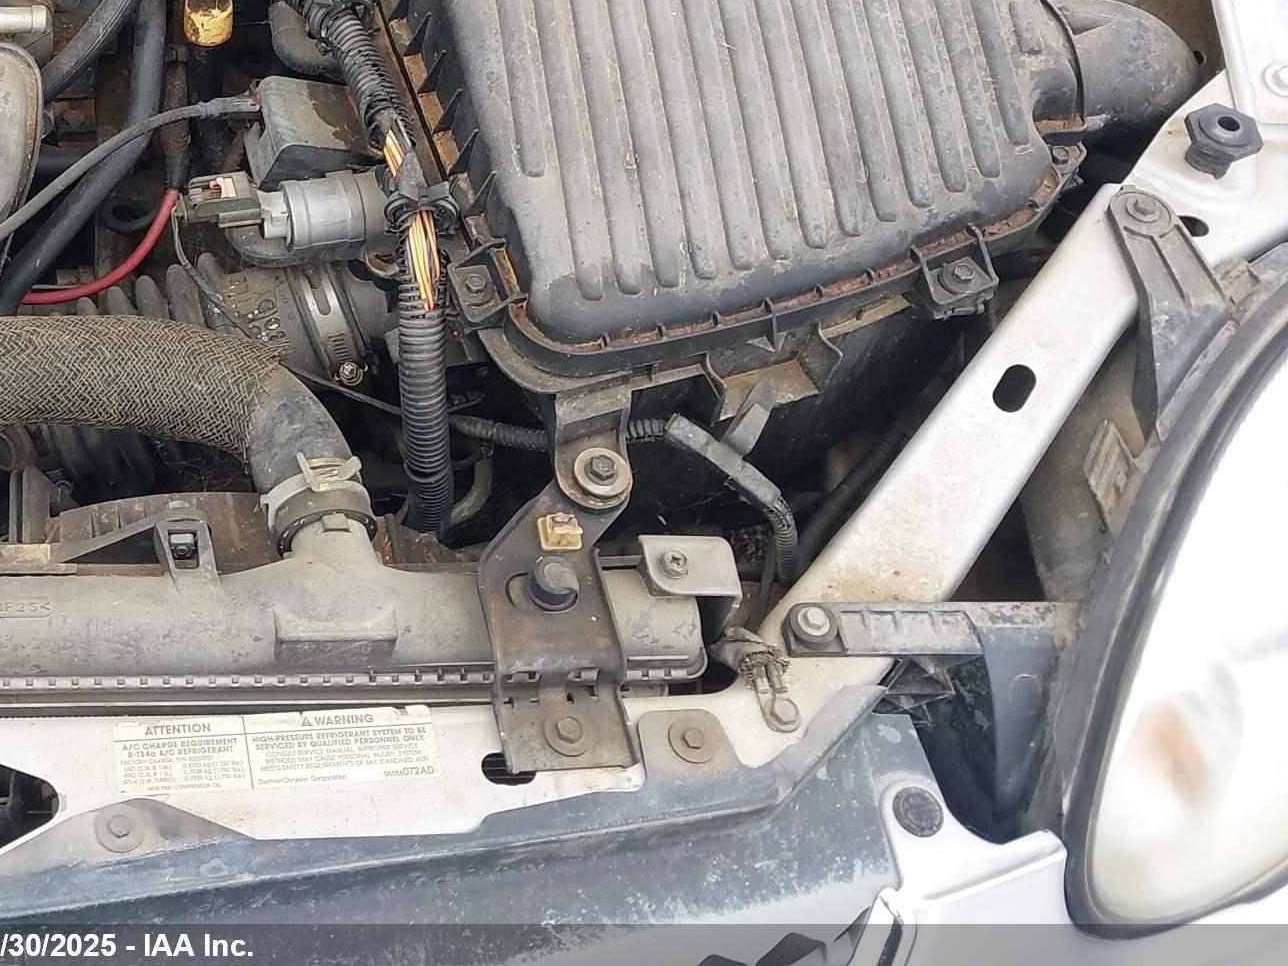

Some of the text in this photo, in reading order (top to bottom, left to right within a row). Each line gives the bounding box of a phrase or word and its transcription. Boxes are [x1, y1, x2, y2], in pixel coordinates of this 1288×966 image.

[315, 714, 374, 726] WARNING
[145, 722, 211, 736] ATTENTION
[253, 733, 313, 742] HIGH-PRESSURE
[316, 730, 370, 739] REFRIGERANT
[372, 728, 401, 736] SYSTEM
[122, 738, 237, 751] A/C CHARGE REQUIREMENT
[255, 742, 295, 750] SERVICED
[310, 738, 351, 747] QUALIFIED
[354, 736, 400, 745] PERSONNEL
[177, 746, 233, 755] REFRIGERANT
